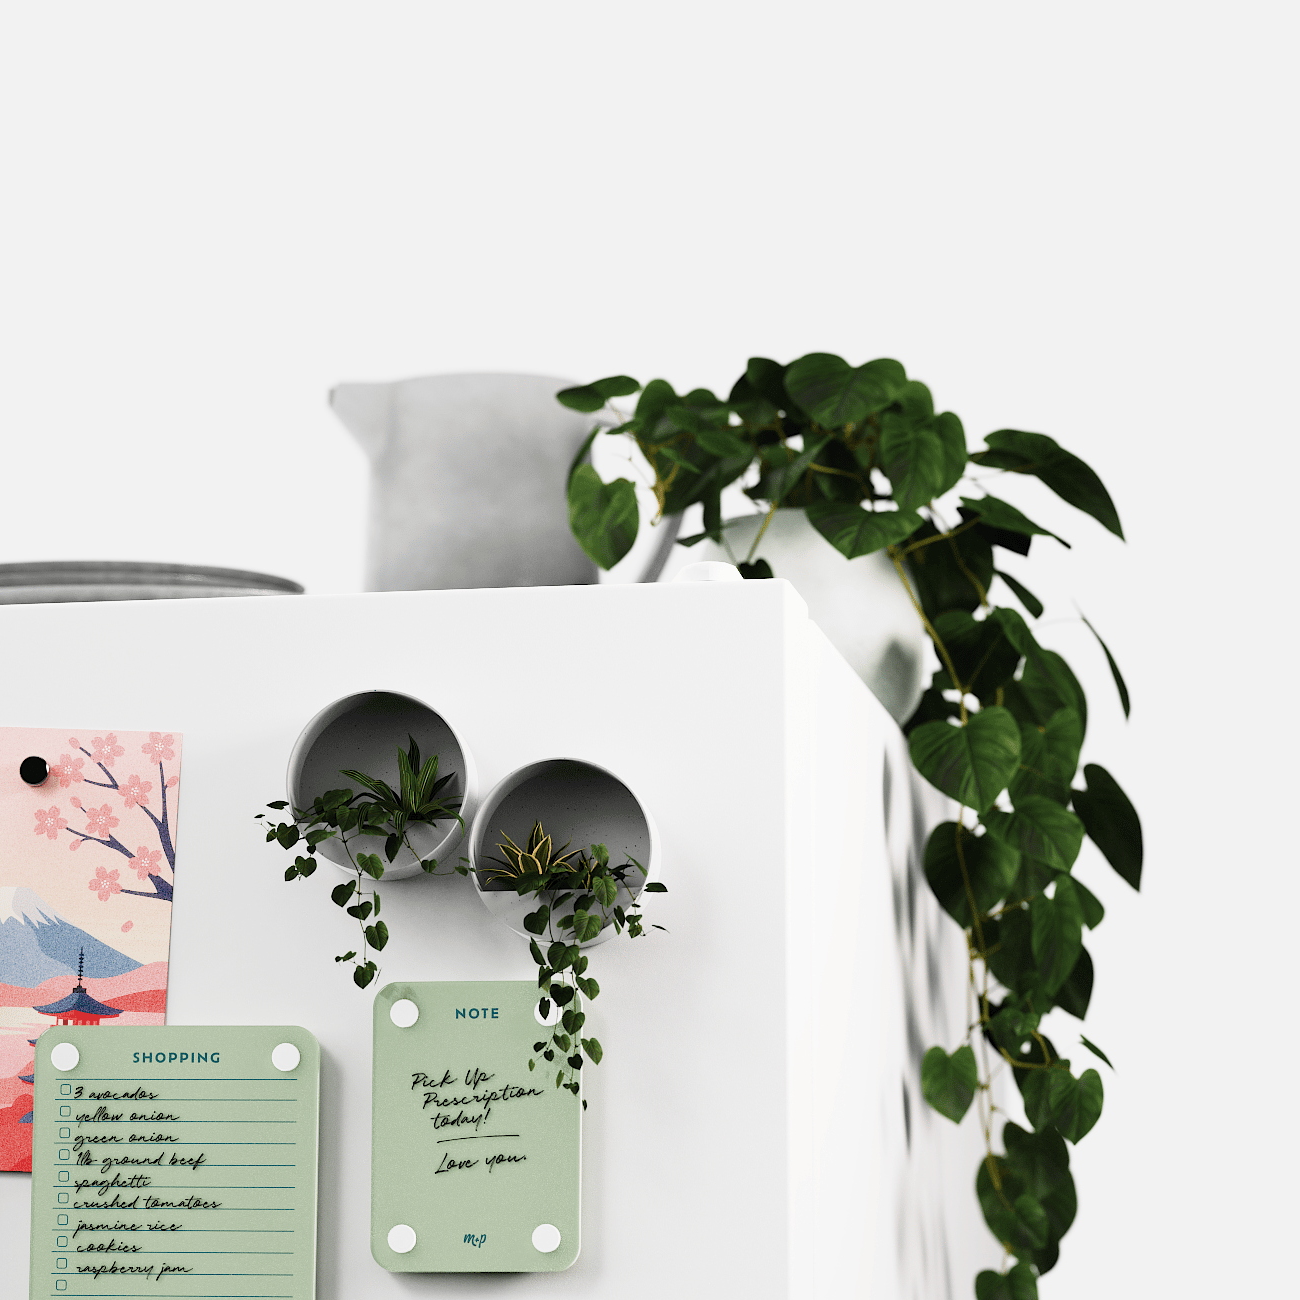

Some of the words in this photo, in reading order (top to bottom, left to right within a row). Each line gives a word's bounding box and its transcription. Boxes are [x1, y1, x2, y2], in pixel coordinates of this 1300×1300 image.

[456, 1008, 499, 1019] NOTE
[133, 1053, 220, 1063] SHOPPING
[411, 1070, 458, 1090] Pick
[465, 1068, 495, 1089] Up
[73, 1086, 84, 1100] 3
[88, 1087, 159, 1100] avocados
[423, 1084, 544, 1110] Prescription
[76, 1106, 123, 1127] yellow
[130, 1111, 180, 1121] onion
[430, 1107, 491, 1131] today!
[73, 1133, 123, 1151] green
[129, 1133, 179, 1143] onion
[102, 1152, 164, 1173] ground
[169, 1153, 207, 1170] beef
[435, 1152, 479, 1174] Love
[485, 1153, 527, 1173] you.
[74, 1173, 152, 1196] spaghetti
[73, 1193, 139, 1209] crushed
[143, 1195, 222, 1209] tomatoes
[73, 1220, 143, 1239] jasmine
[147, 1221, 182, 1232] rice
[76, 1238, 142, 1252] cookies
[77, 1260, 153, 1280] raspberry
[156, 1262, 193, 1281] jam
